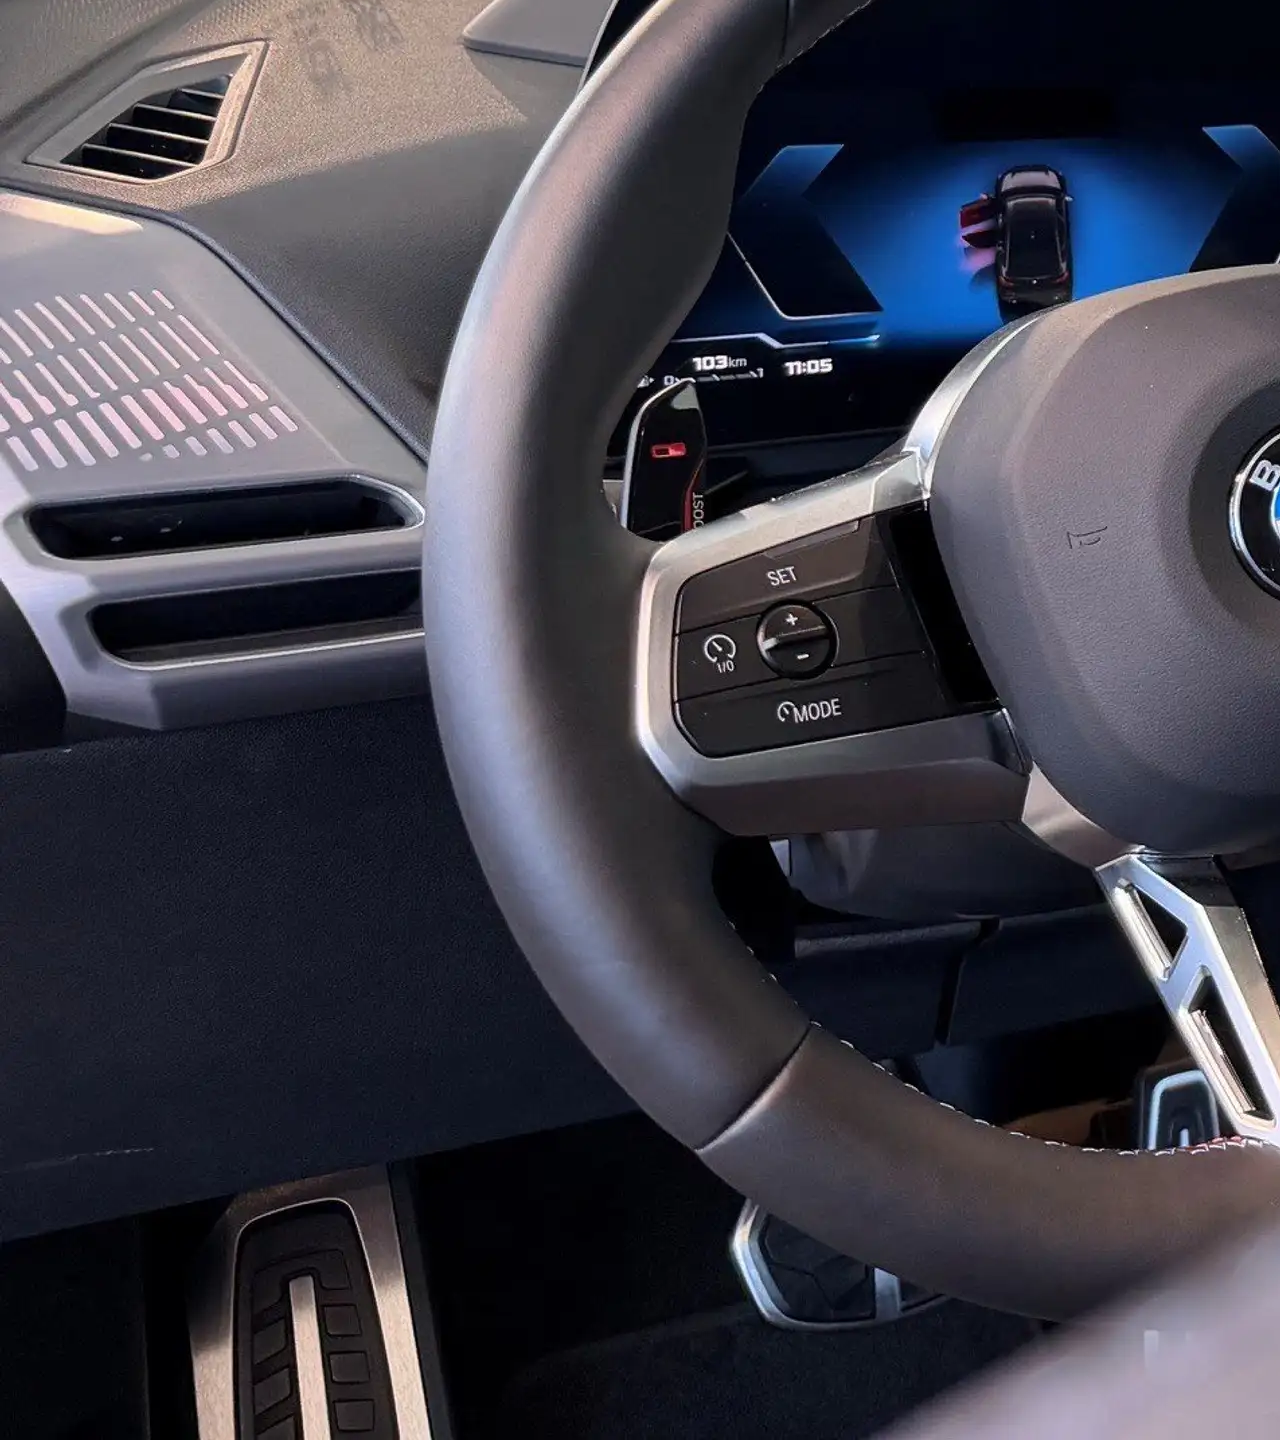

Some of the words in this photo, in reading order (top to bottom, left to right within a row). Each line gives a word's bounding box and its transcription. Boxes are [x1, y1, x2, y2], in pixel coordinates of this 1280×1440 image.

[784, 358, 833, 376] 11:05
[692, 491, 705, 530] OOST
[767, 566, 797, 587] SET
[793, 698, 842, 724] MODE
